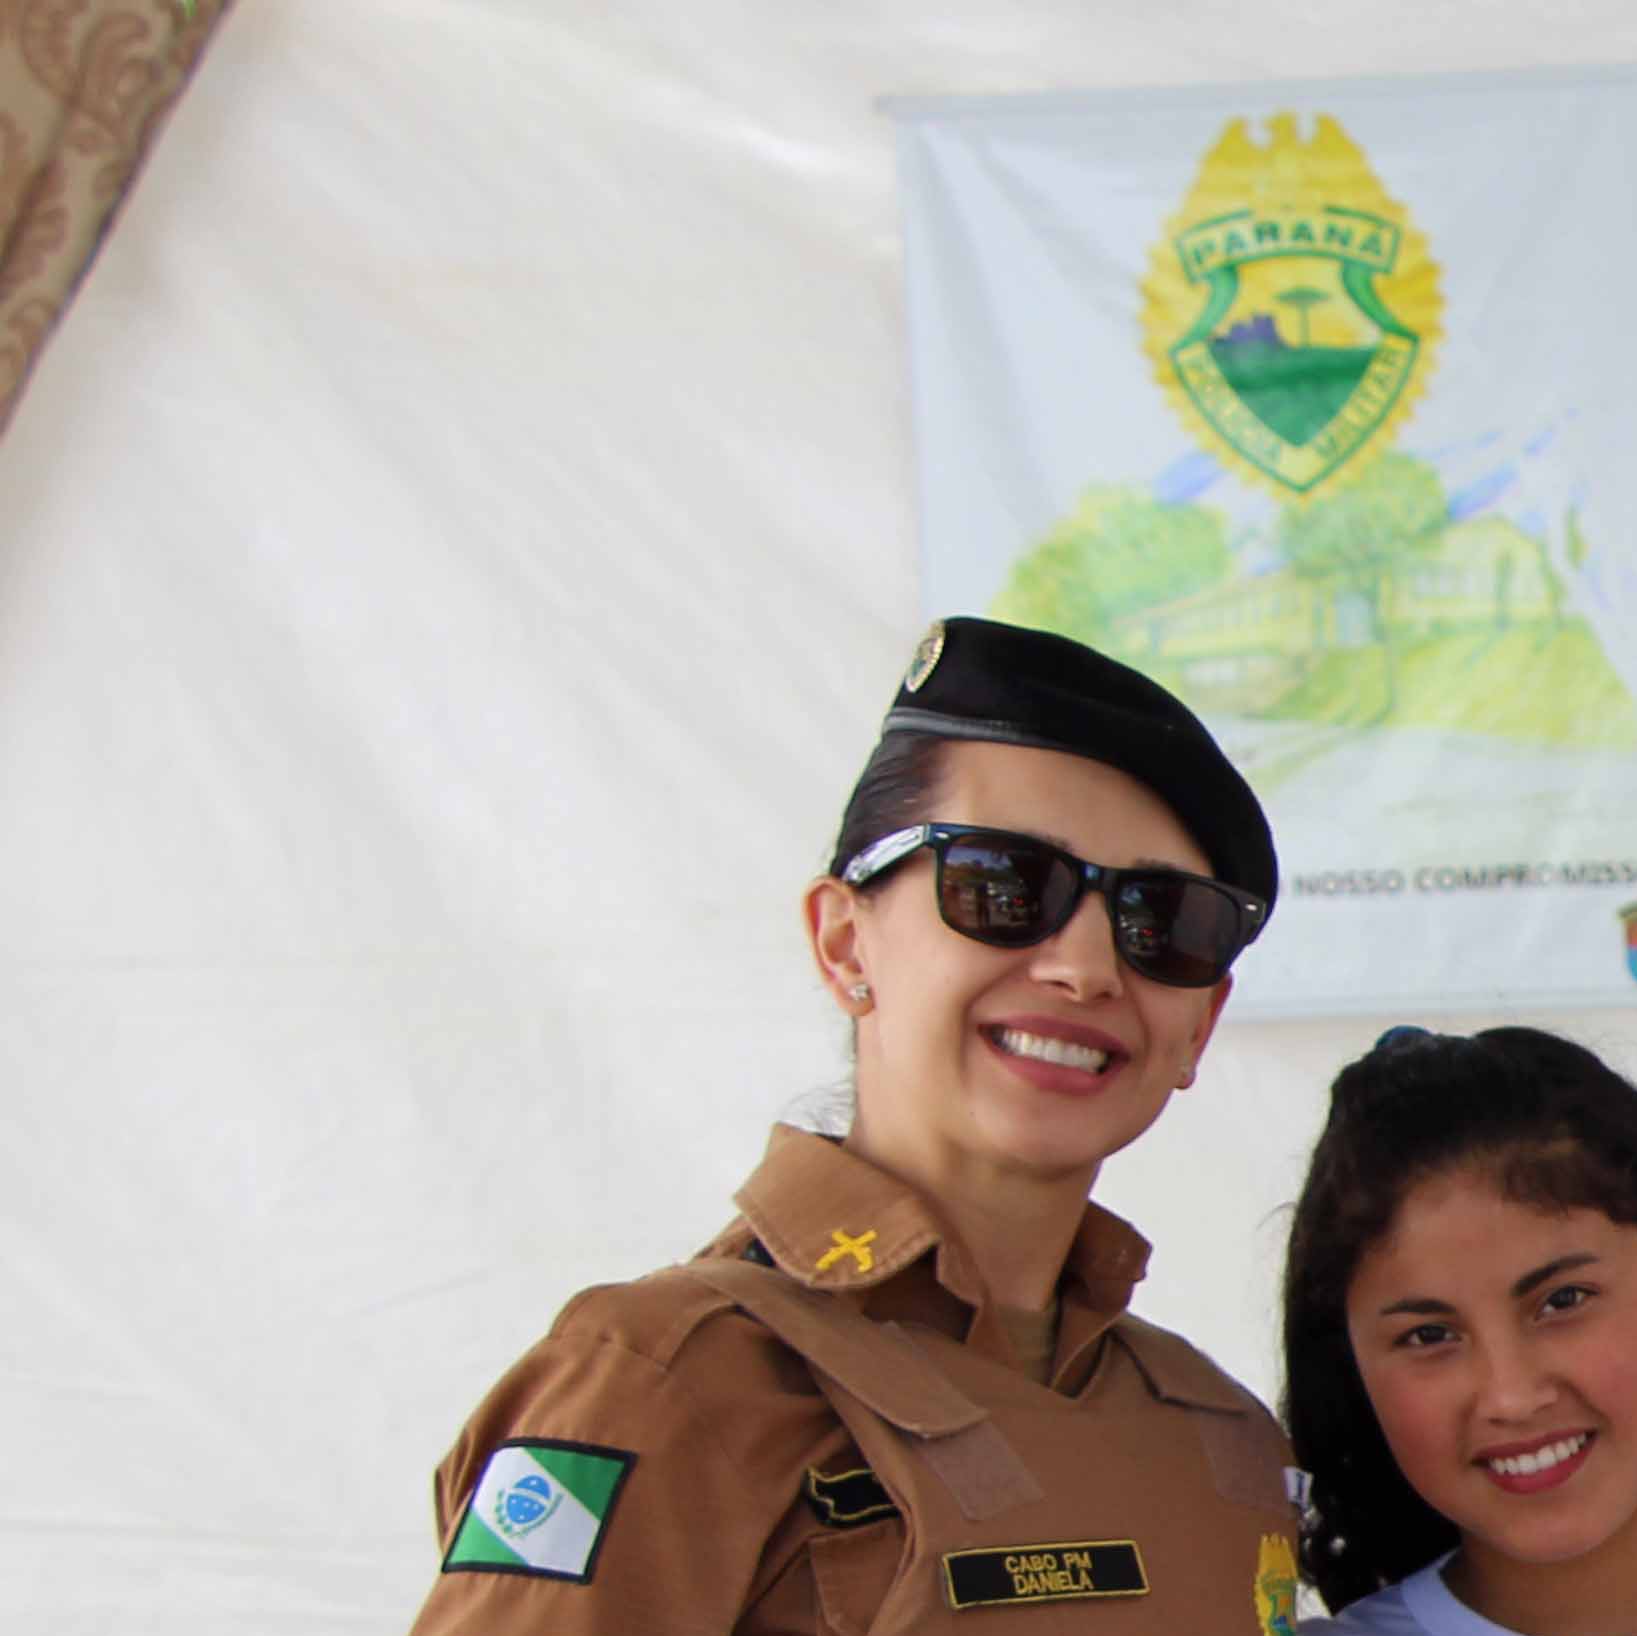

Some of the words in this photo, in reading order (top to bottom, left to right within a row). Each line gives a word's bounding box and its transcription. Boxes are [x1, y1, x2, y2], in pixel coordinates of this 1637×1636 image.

[1293, 869, 1404, 898] NOSSO
[1005, 1553, 1057, 1573] CABO
[1063, 1551, 1093, 1570] PM
[1014, 1570, 1094, 1595] DANIELA
